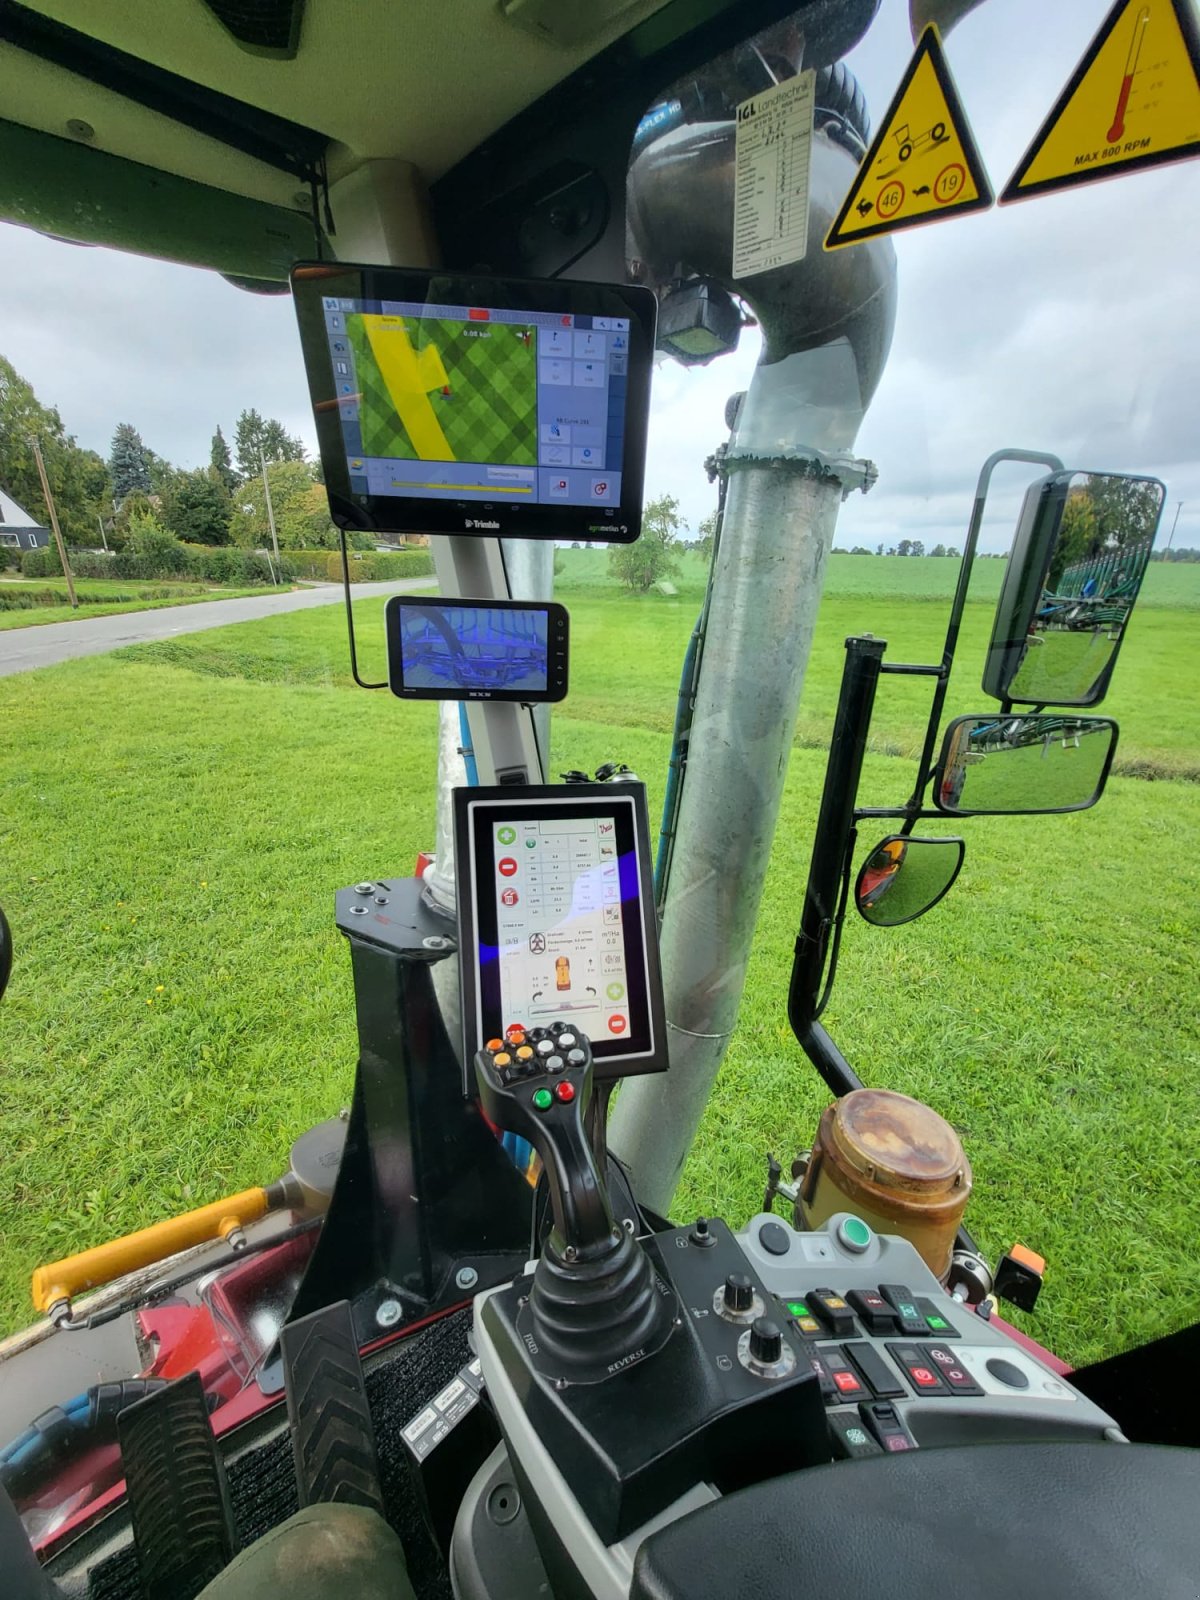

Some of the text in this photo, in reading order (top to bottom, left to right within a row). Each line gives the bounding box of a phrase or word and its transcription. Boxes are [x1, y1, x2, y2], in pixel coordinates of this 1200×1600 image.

[738, 102, 756, 122] IGL
[1074, 137, 1151, 167] MAX 800 RPM
[941, 175, 958, 193] 19
[882, 192, 899, 208] 46
[473, 519, 500, 529] Trimble
[522, 1333, 539, 1355] FIXED
[607, 1349, 646, 1374] REVERSE
